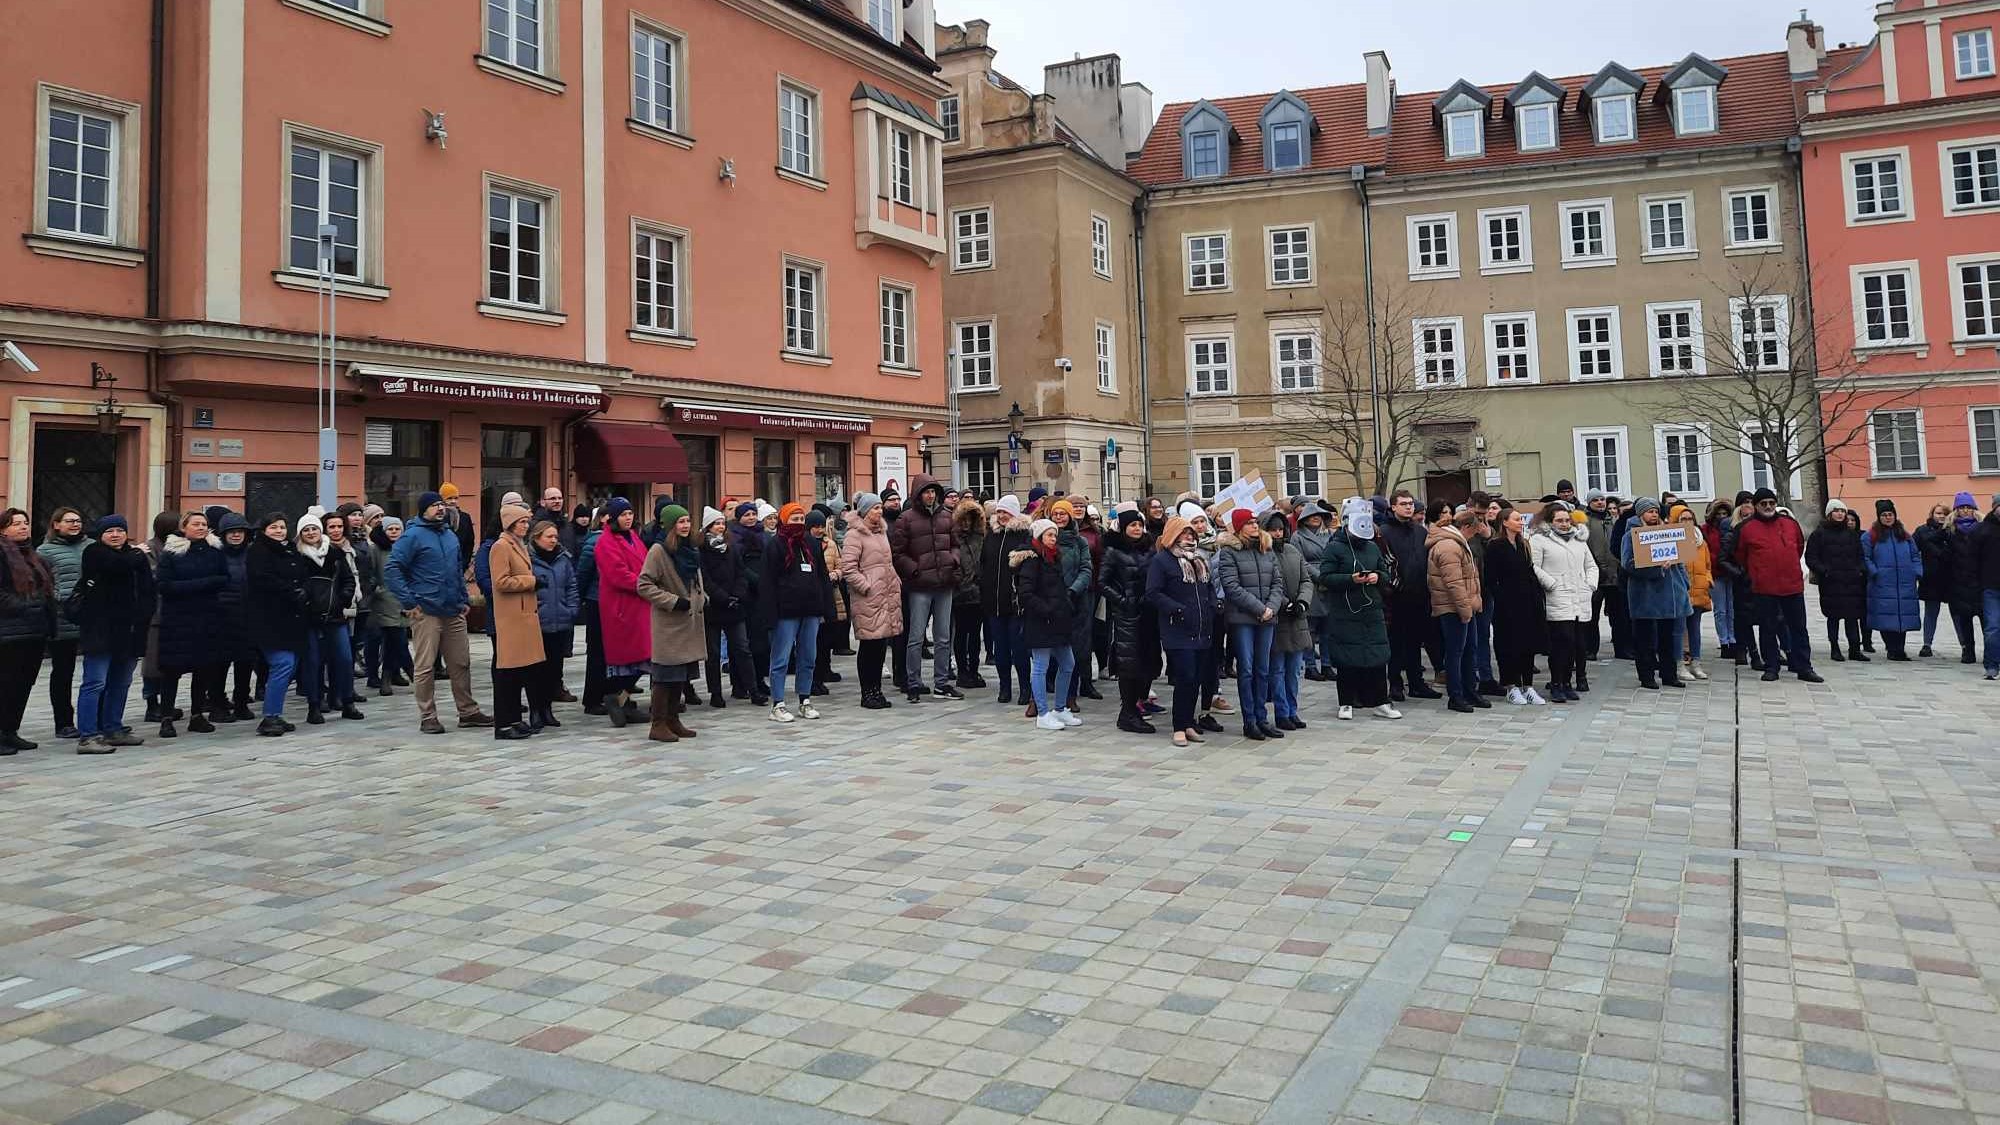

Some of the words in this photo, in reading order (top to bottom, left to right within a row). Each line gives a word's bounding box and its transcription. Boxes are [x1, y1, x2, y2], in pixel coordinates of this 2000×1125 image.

[412, 381, 468, 397] Restauracja
[470, 386, 514, 399] Republika
[532, 390, 542, 402] by
[544, 391, 574, 405] Andrzej
[1640, 531, 1684, 541] ZAPOMNIANI
[1652, 546, 1676, 558] 2024
